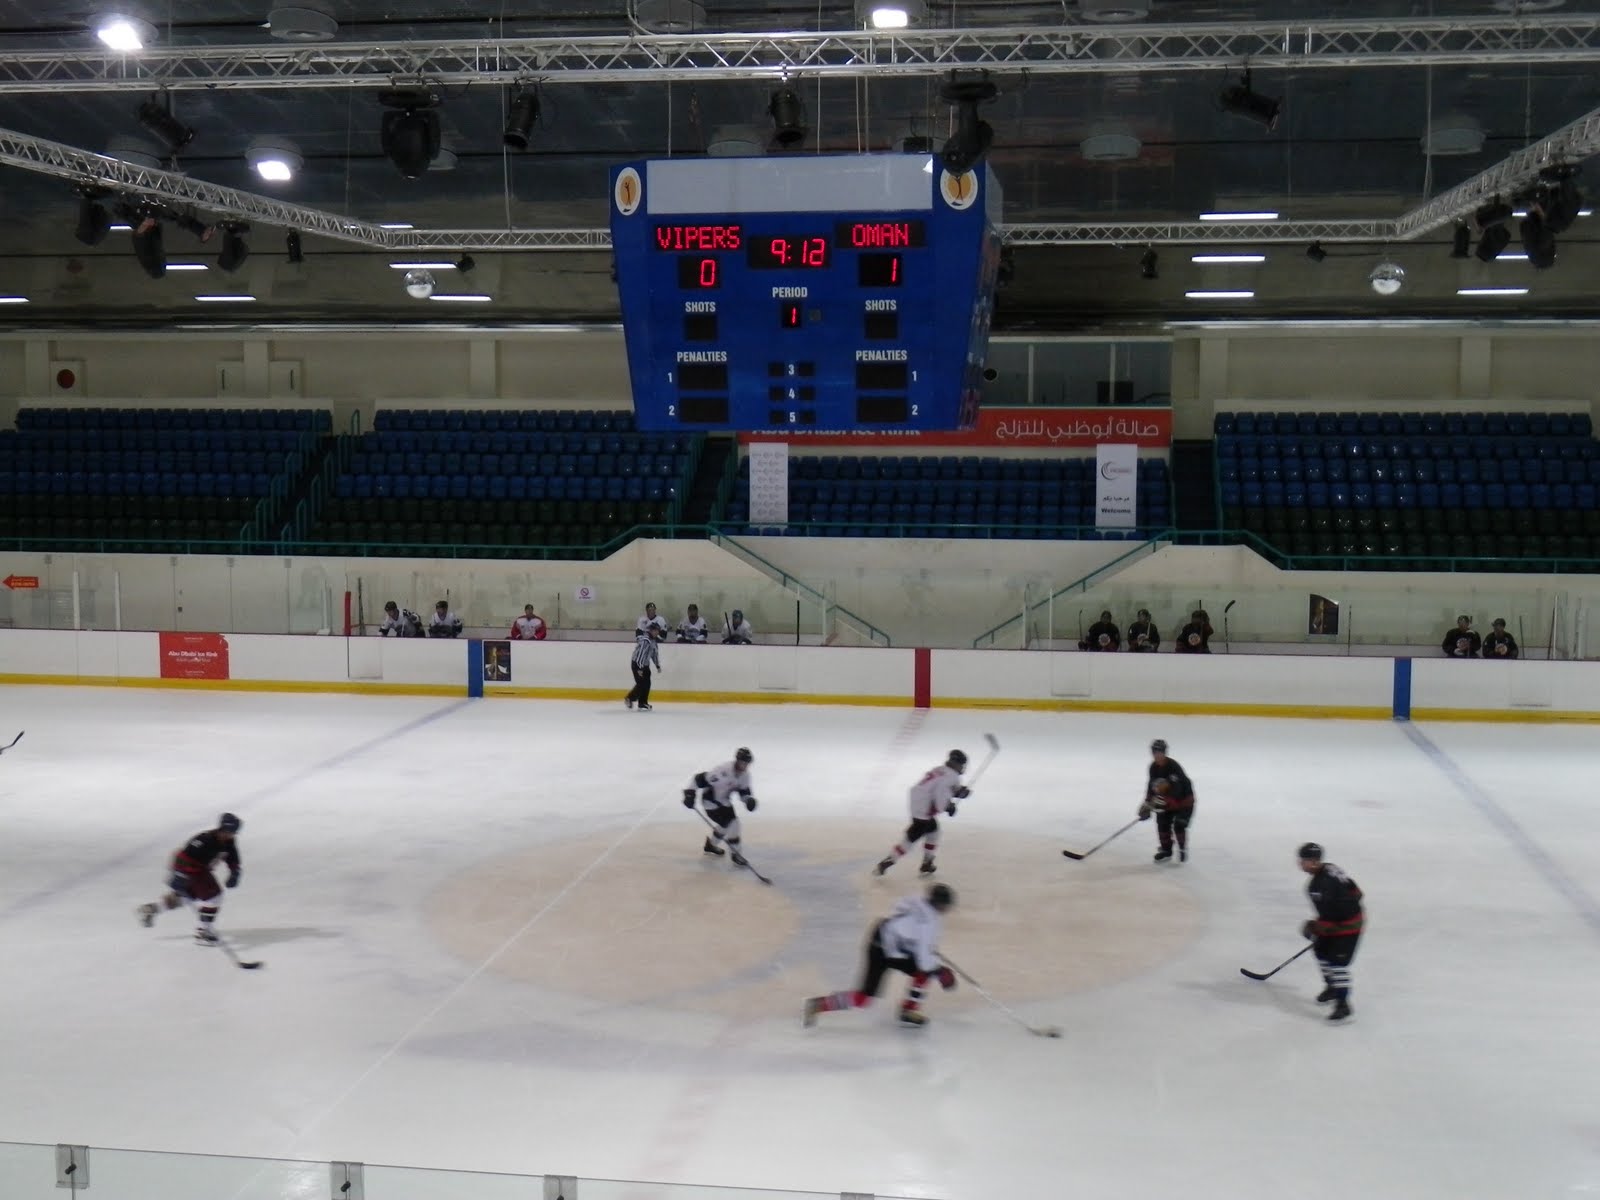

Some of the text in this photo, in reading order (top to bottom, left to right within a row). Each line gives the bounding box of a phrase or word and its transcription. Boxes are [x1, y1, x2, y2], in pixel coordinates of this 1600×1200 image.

[657, 226, 740, 249] VIPERS
[852, 223, 909, 246] OMAN
[771, 238, 826, 266] 9:12
[700, 259, 716, 286] 0
[891, 258, 898, 282] 1
[772, 287, 808, 298] PERIOD
[685, 302, 716, 312] SHOTS
[865, 300, 897, 311] SHOTS
[791, 307, 797, 324] 1
[676, 351, 728, 362] PENALTIES
[855, 350, 908, 361] PENALTIES
[788, 364, 795, 375] 3
[667, 372, 673, 383] 1
[911, 371, 917, 381] 1
[788, 388, 796, 399] 4
[668, 405, 675, 416] 2
[911, 405, 918, 416] 2
[789, 412, 796, 422] 5
[996, 416, 1159, 442] صالة أبوظبي للتزلج
